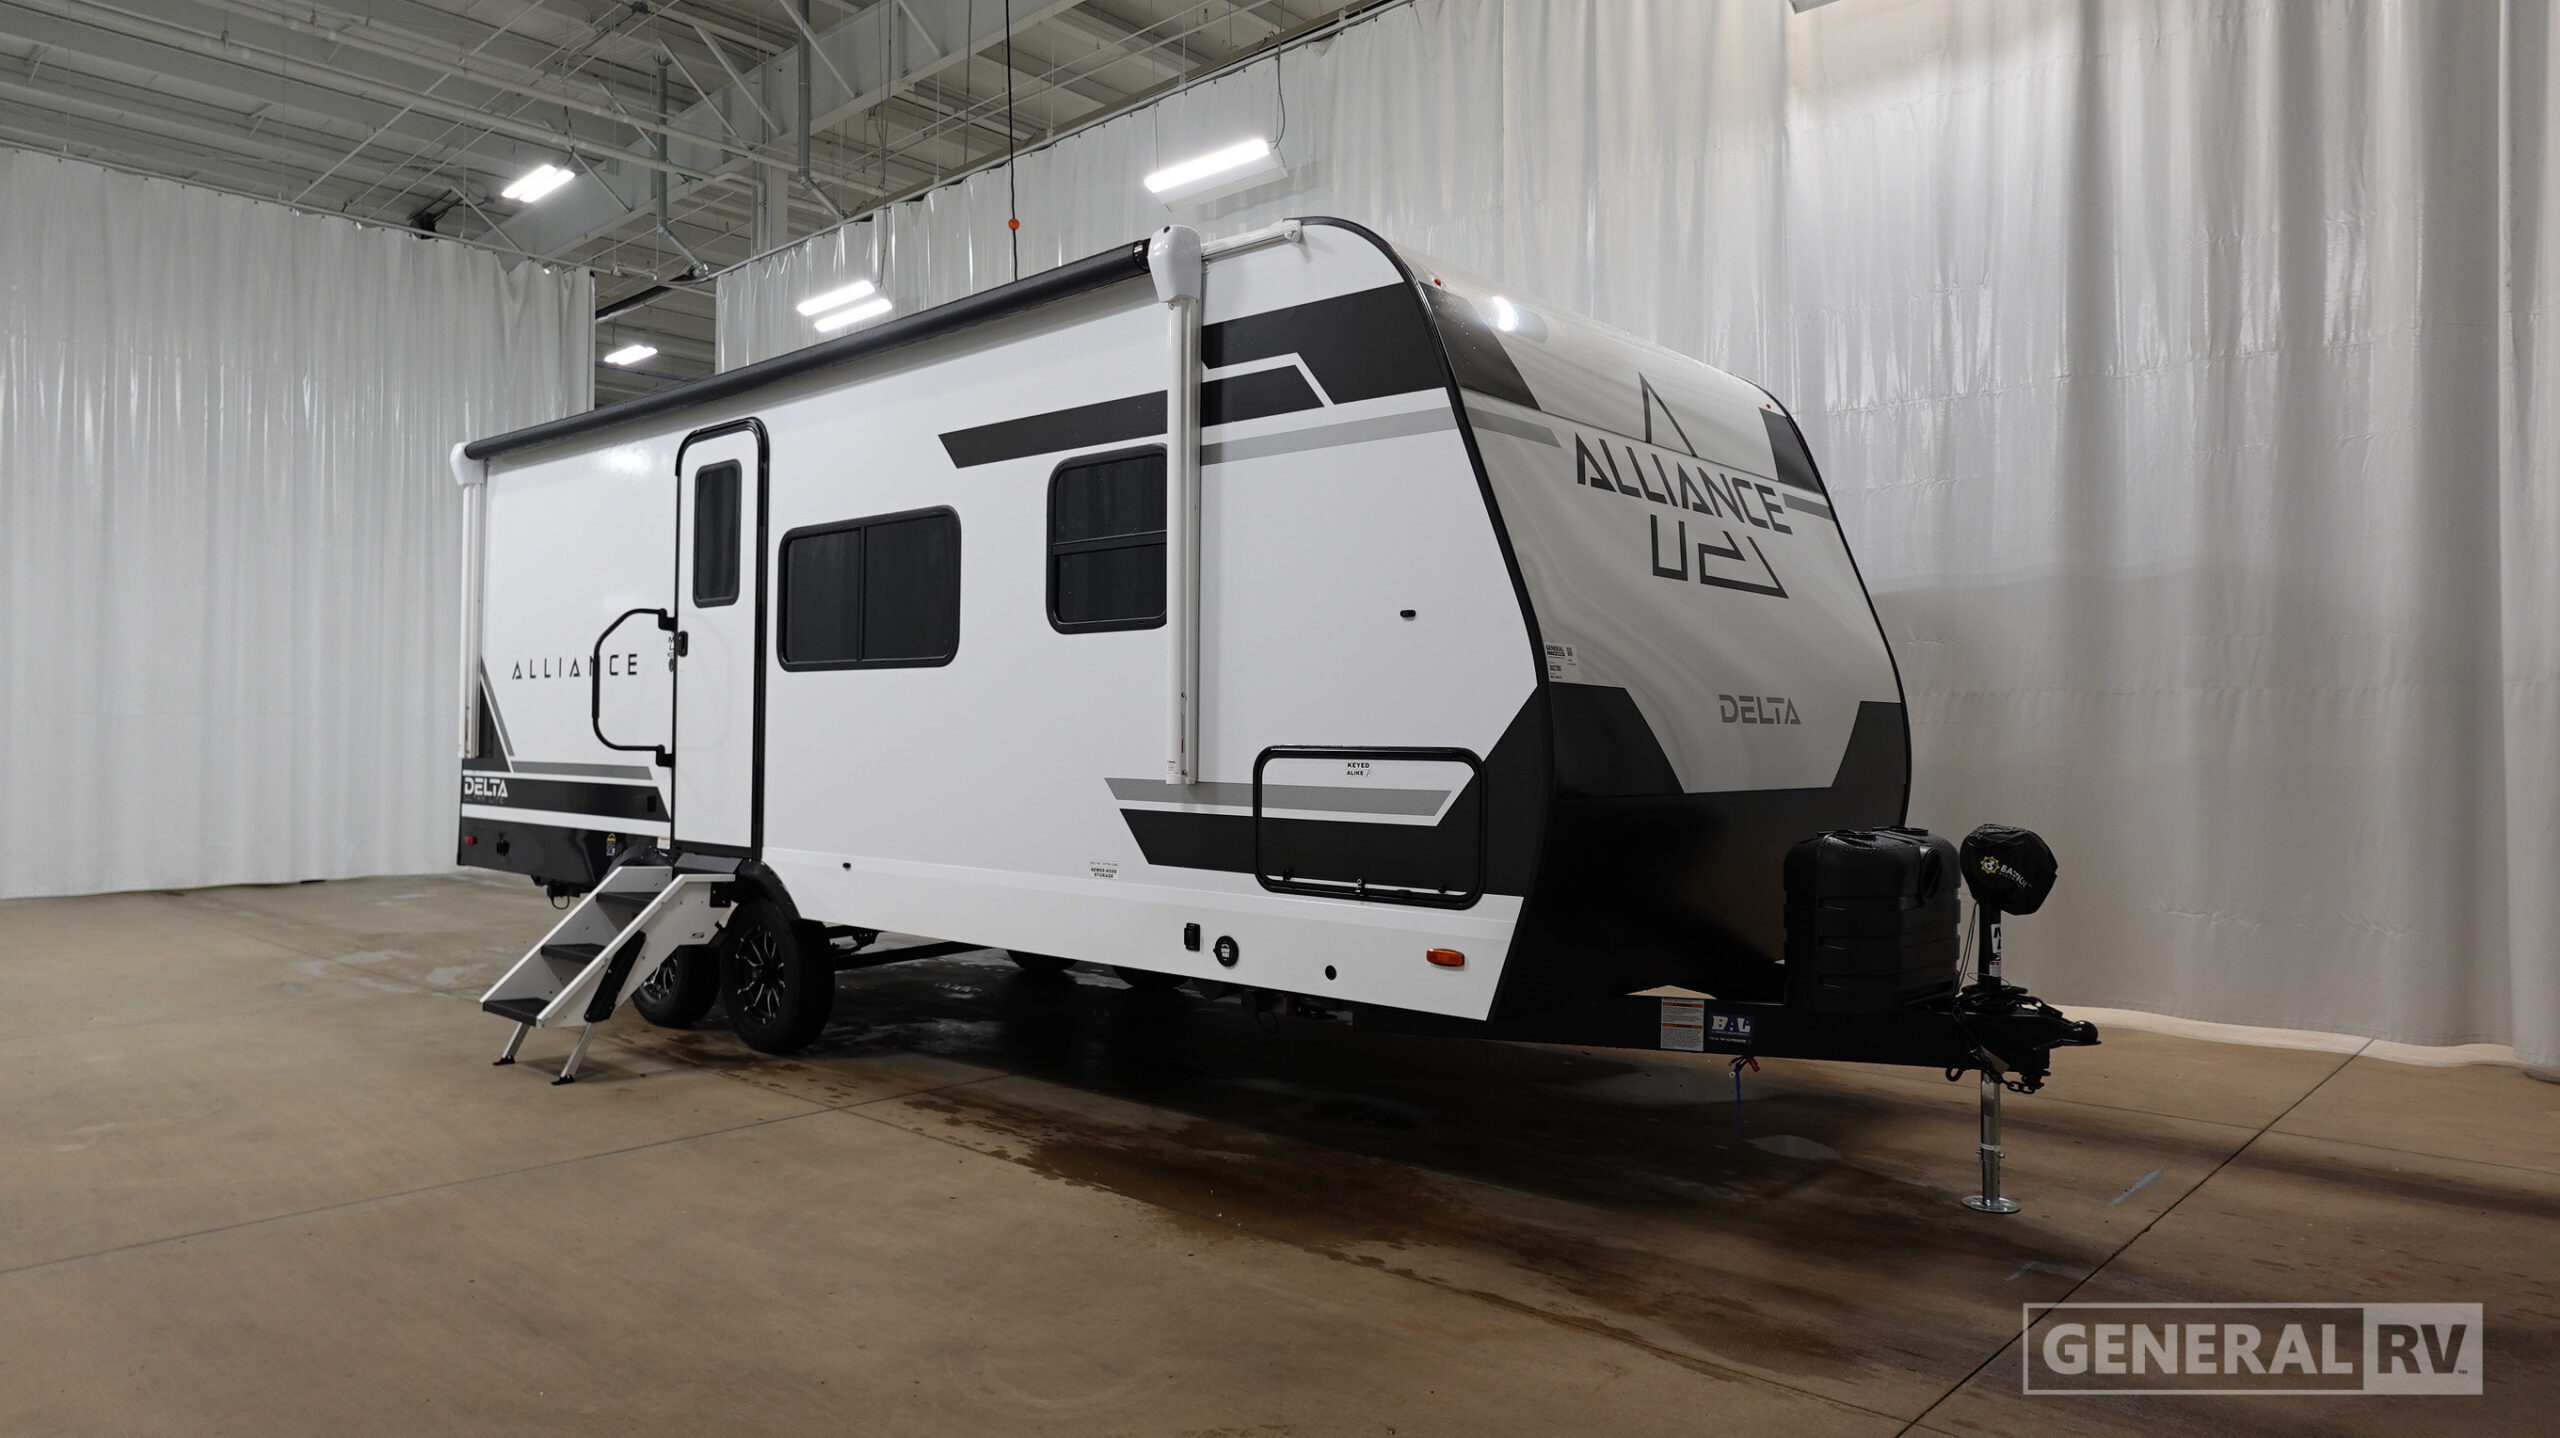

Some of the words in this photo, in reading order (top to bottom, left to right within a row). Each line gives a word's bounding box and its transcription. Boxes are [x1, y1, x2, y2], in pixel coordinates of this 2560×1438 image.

[1575, 432, 1793, 535] ALLIANCE
[1719, 694, 1802, 725] DELTA
[464, 777, 508, 798] DELTA
